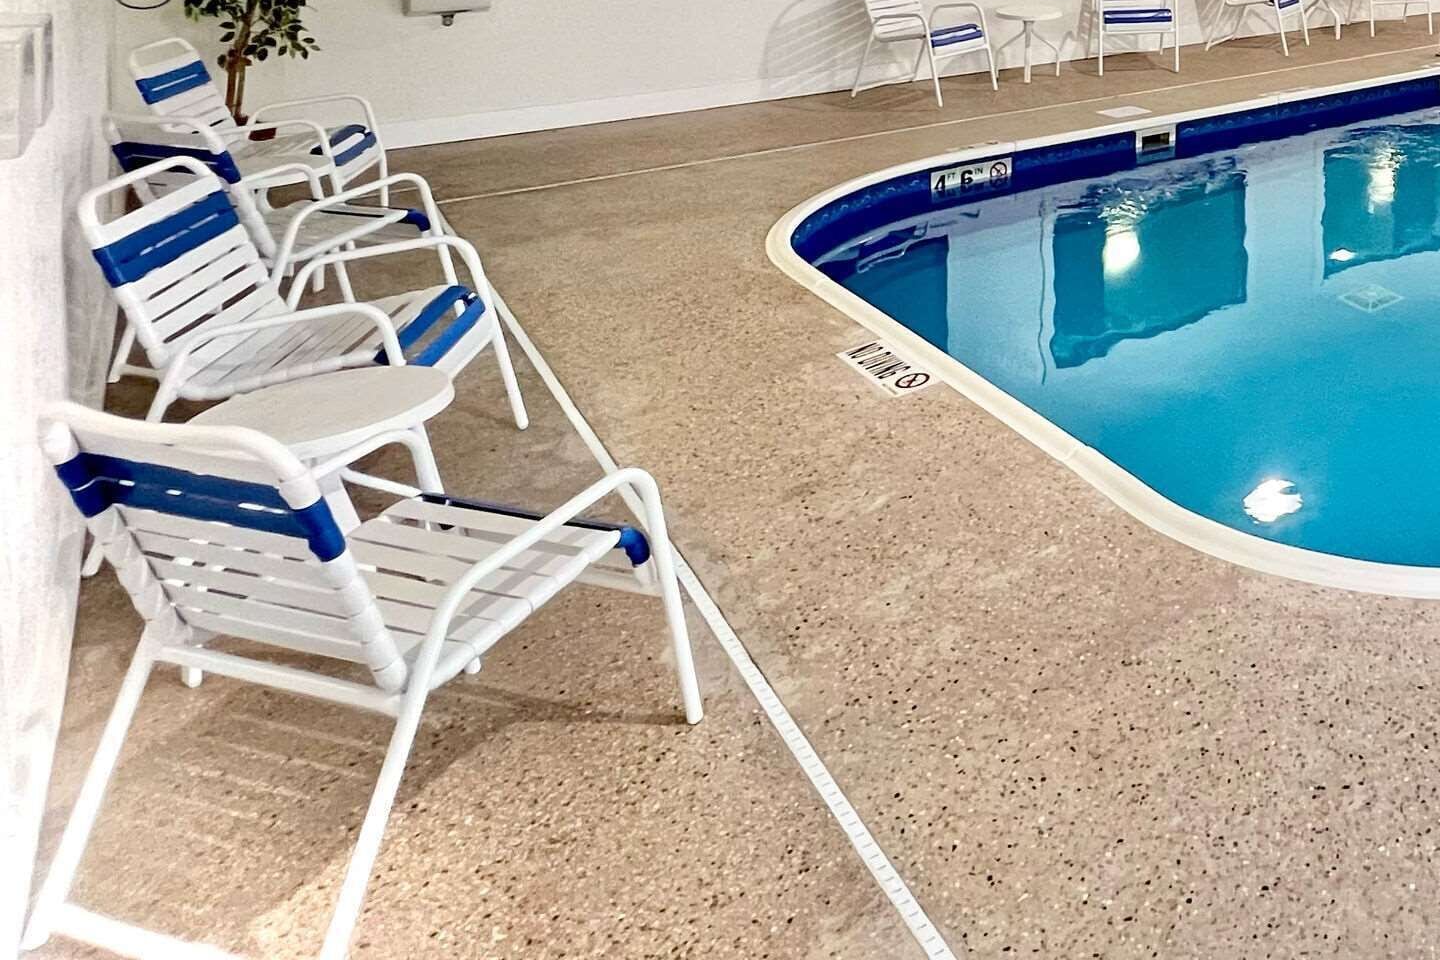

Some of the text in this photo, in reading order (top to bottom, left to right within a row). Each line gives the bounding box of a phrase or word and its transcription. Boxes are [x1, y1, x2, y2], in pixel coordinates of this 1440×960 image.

[933, 174, 946, 192] 4
[947, 172, 956, 180] FT
[960, 169, 974, 185] 6
[845, 342, 912, 380] NO DIVING
